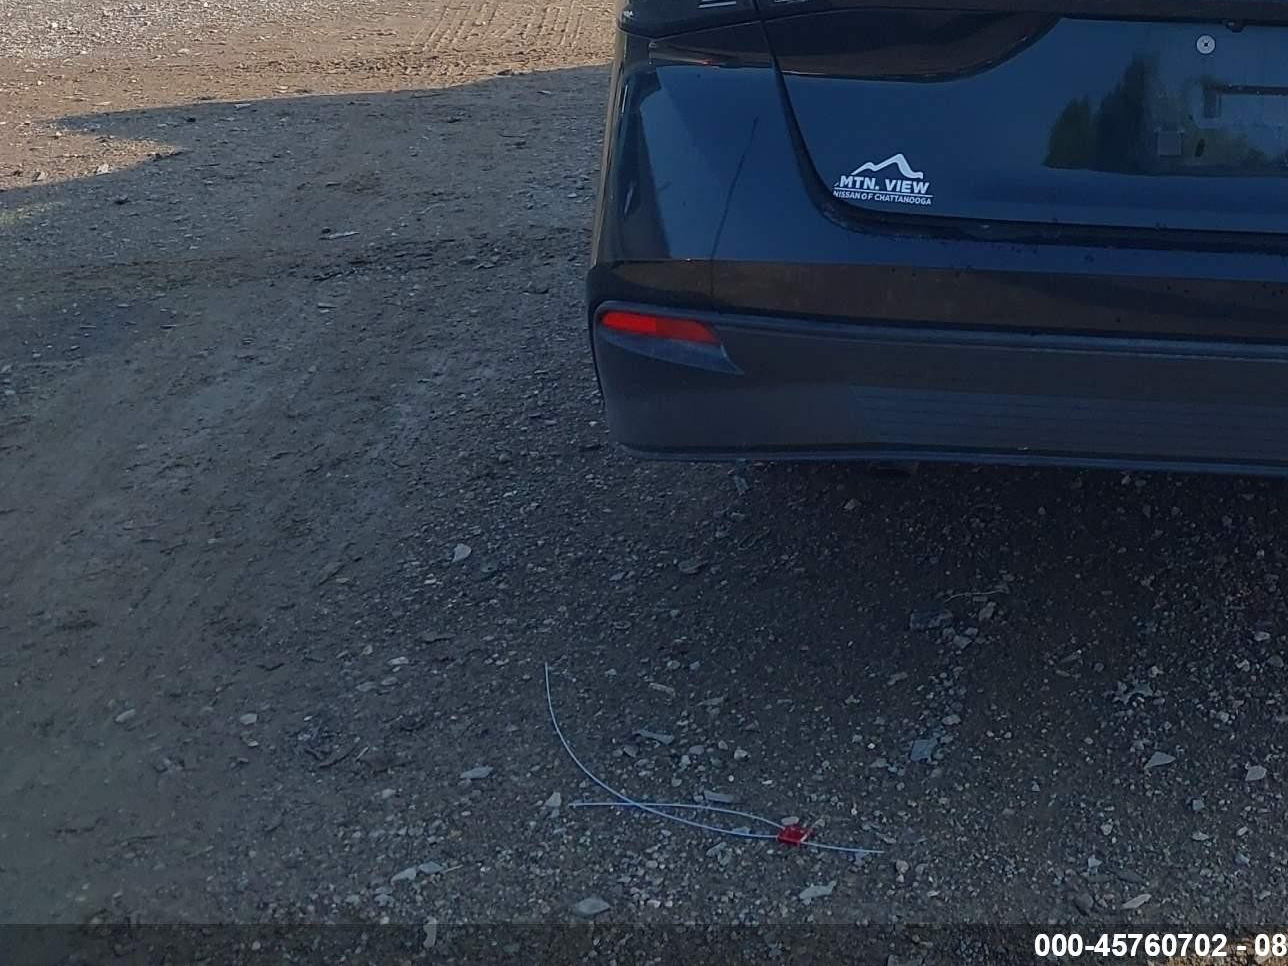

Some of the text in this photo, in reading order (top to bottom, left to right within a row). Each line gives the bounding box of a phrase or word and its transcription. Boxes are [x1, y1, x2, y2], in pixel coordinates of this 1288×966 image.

[840, 175, 930, 194] MTN. VIEW
[833, 190, 861, 200] NISSAN
[861, 192, 873, 200] OF
